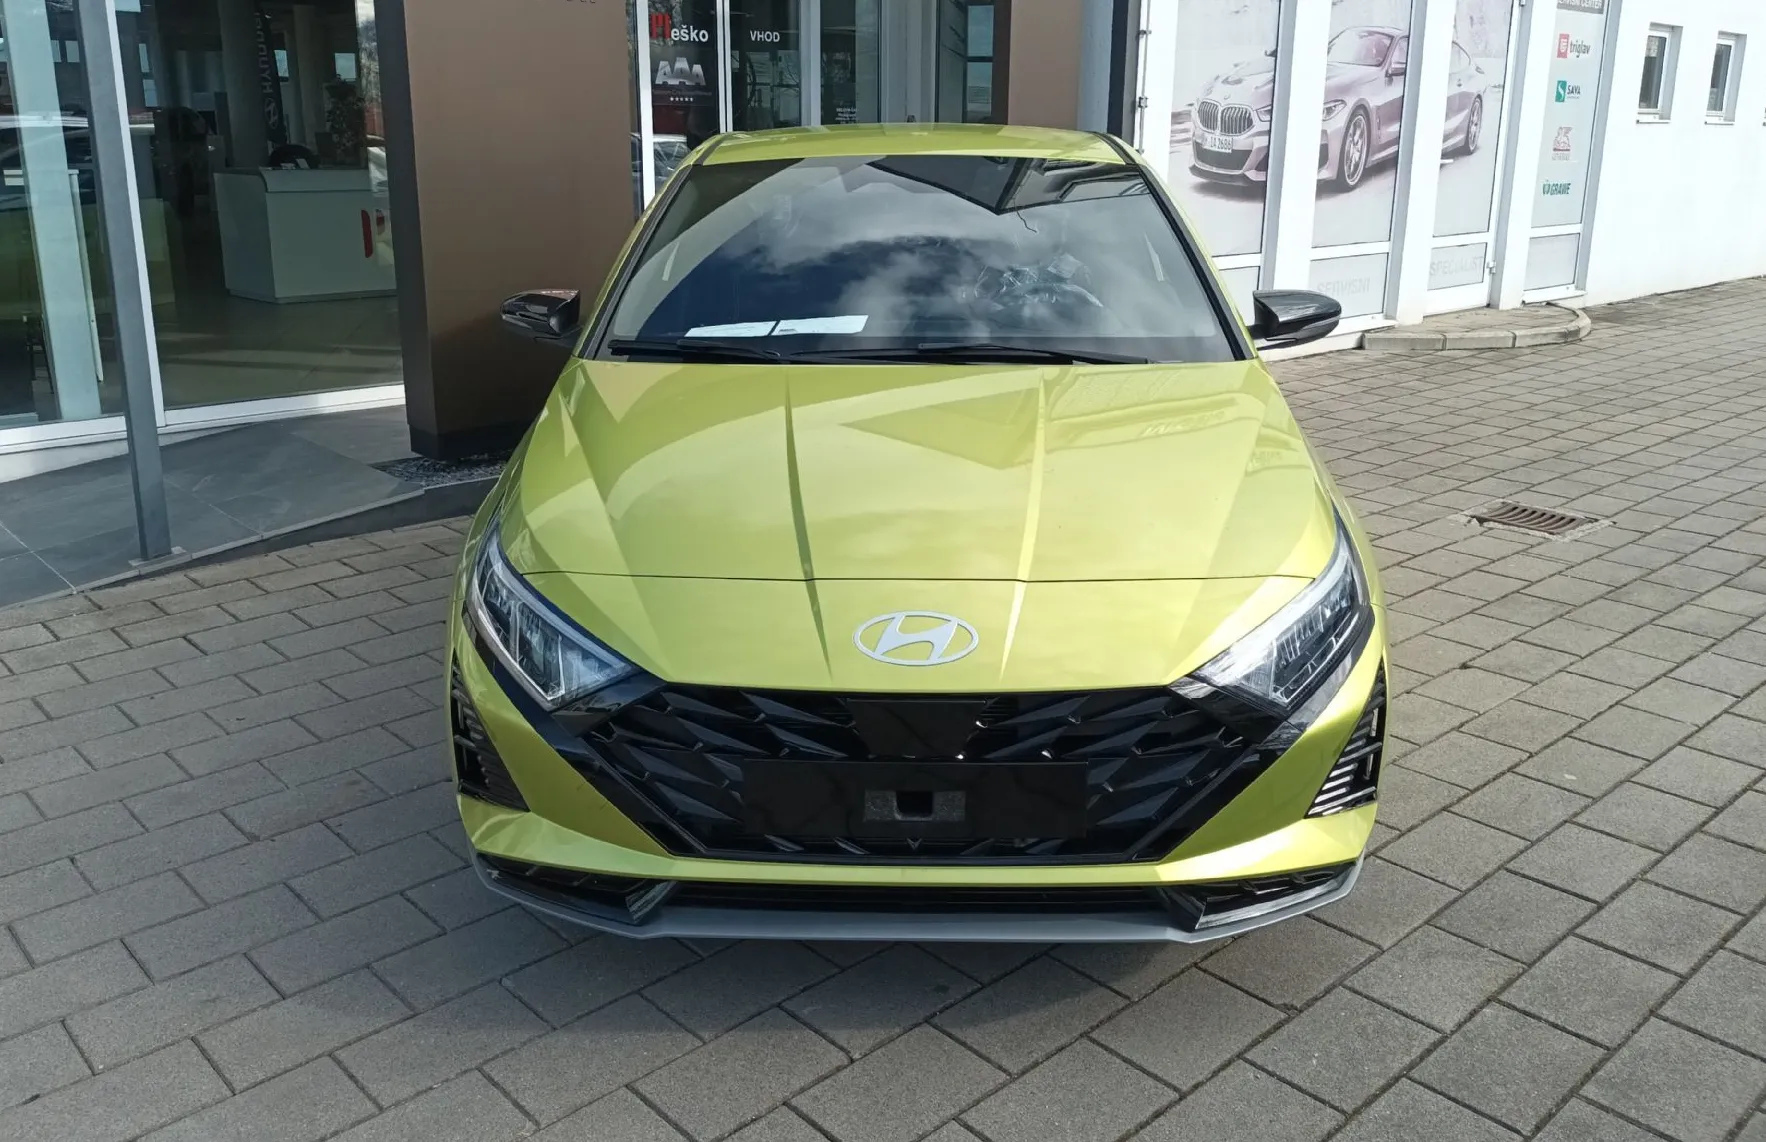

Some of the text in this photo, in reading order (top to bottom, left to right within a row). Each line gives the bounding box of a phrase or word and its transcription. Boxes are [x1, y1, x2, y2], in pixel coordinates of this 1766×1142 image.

[749, 30, 780, 42] VHOD
[1570, 39, 1591, 58] triglav
[655, 57, 706, 86] AAA
[1567, 85, 1581, 95] SAVA
[1550, 182, 1571, 196] GRAWE
[1429, 256, 1484, 276] SPECIALIST
